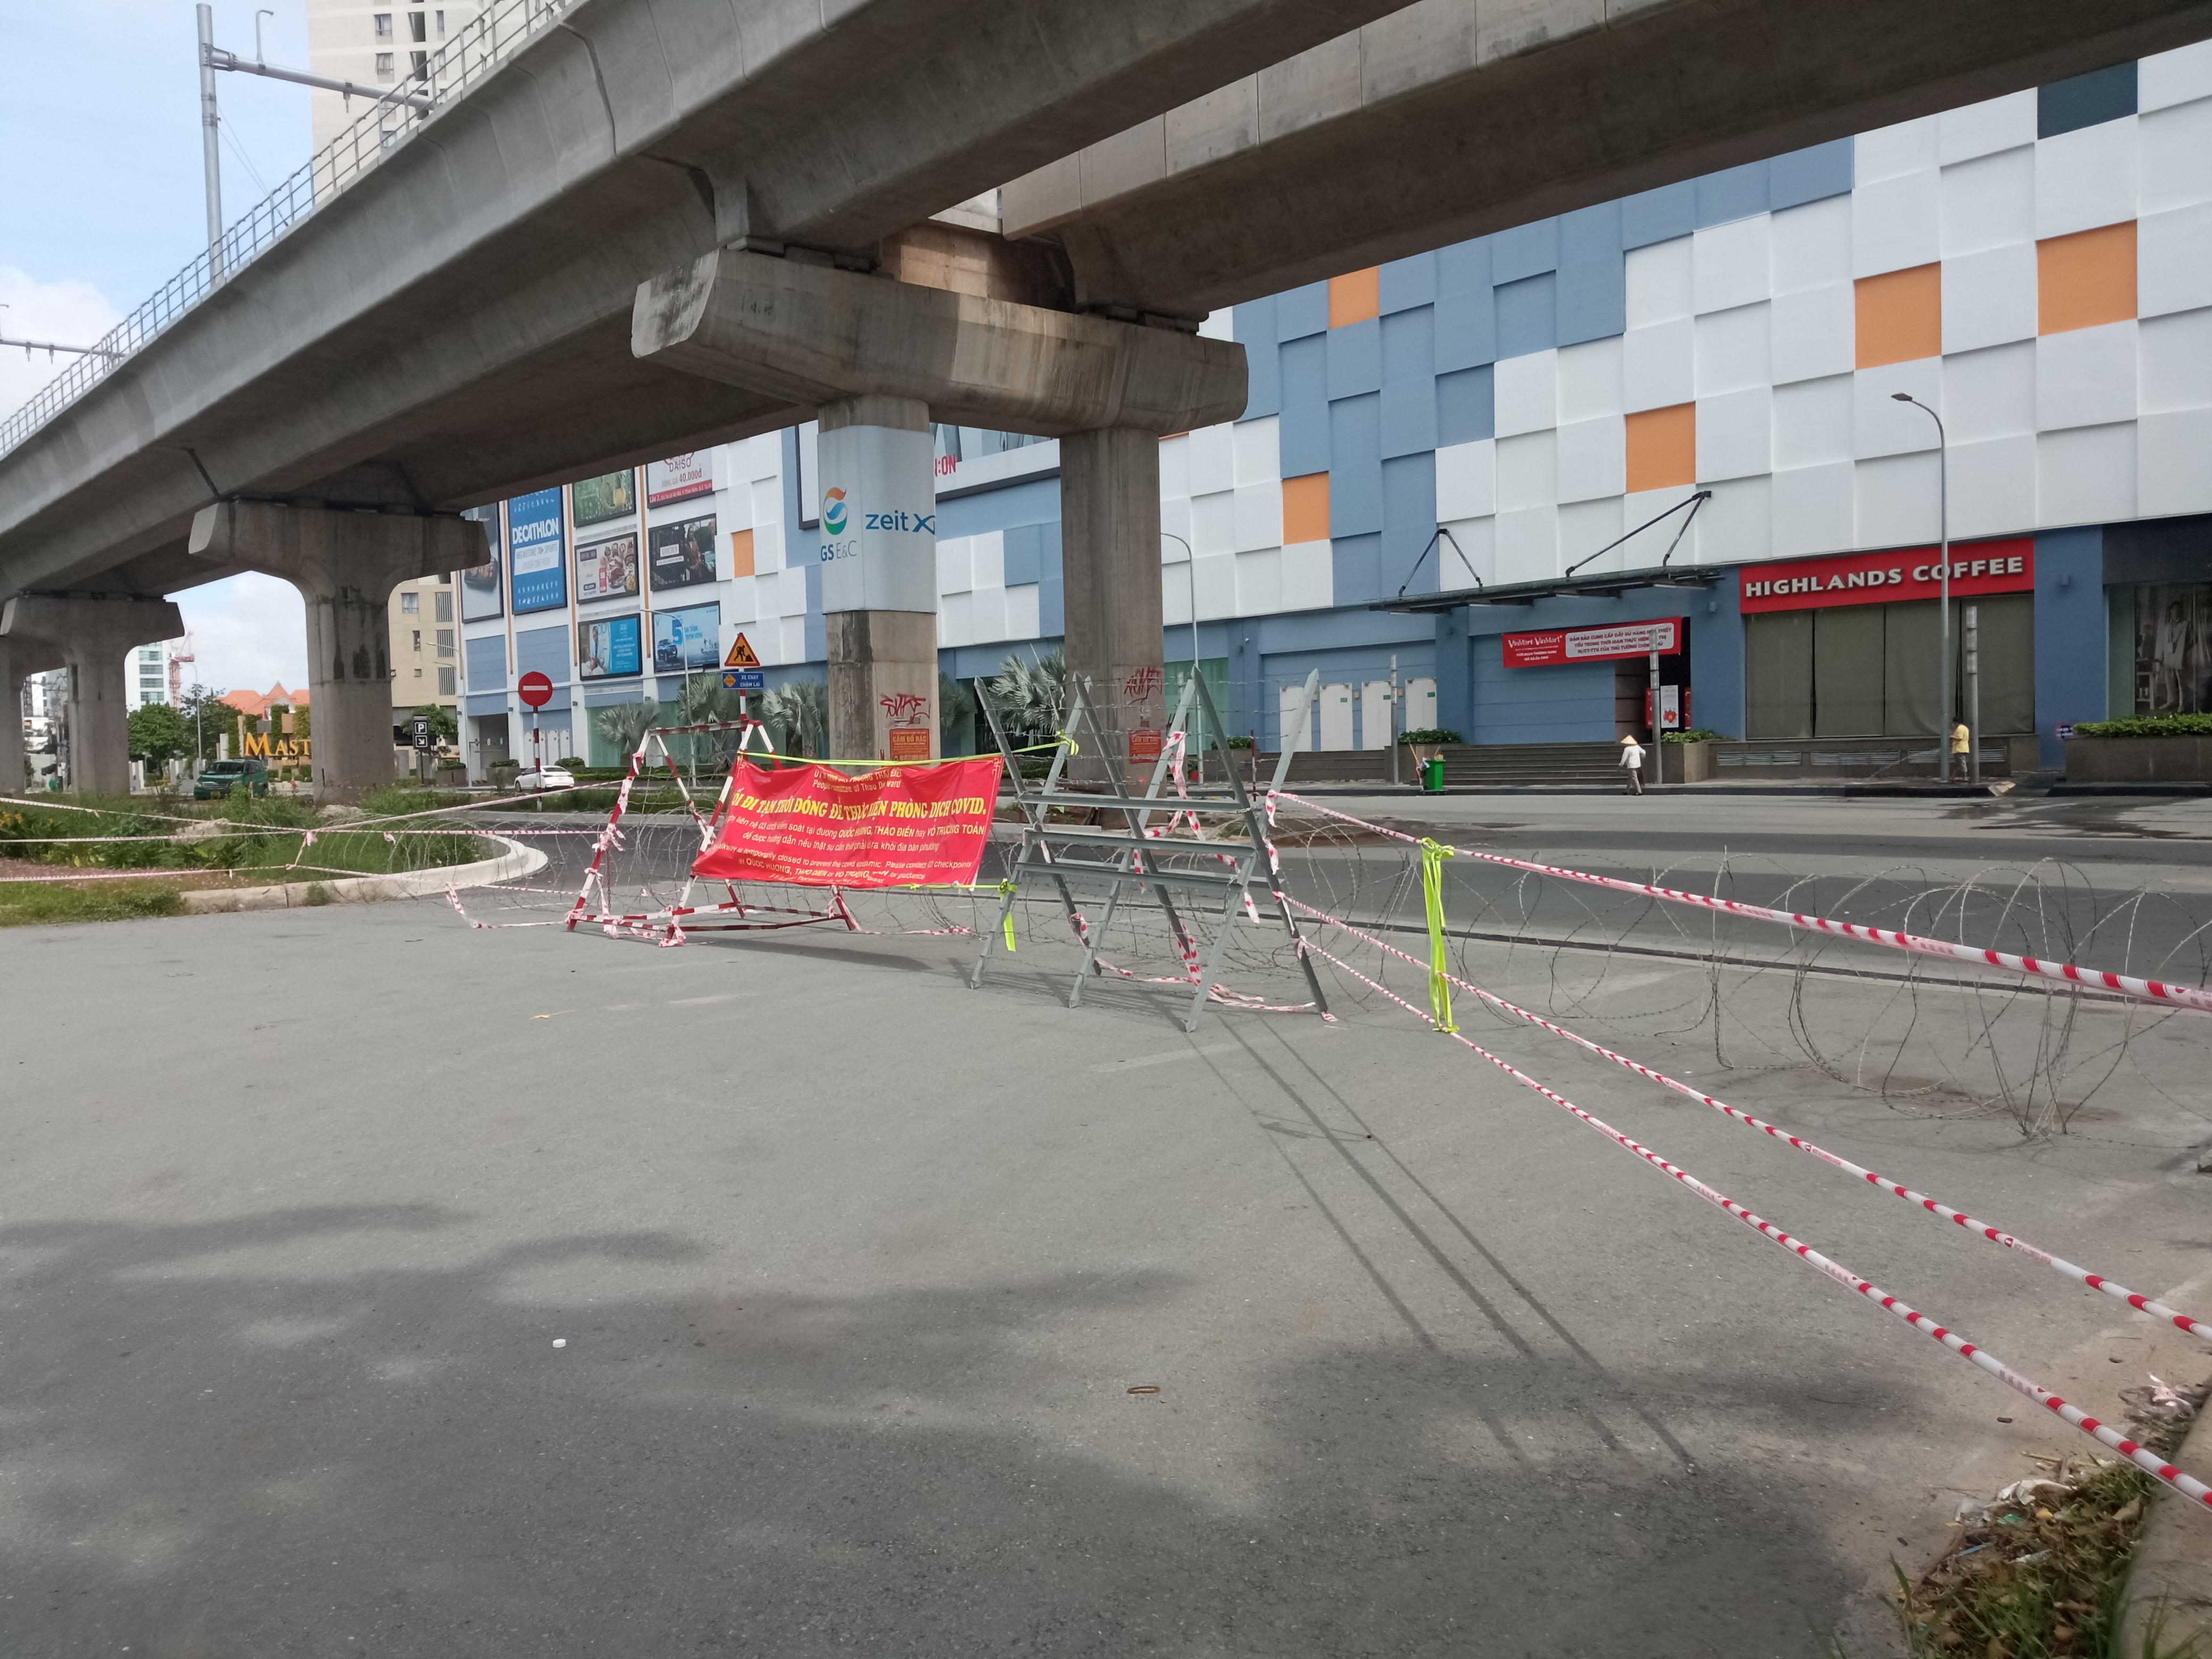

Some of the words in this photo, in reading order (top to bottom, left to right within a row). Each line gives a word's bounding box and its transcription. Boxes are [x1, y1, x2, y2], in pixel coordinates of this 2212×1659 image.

[669, 457, 691, 473] DAISO
[679, 468, 702, 483] 40.000đ
[512, 517, 559, 544] DECATHLON
[820, 543, 834, 562] GS
[836, 540, 858, 559] E&C
[1745, 568, 1903, 597] HIGHLANDS
[1913, 556, 2023, 582] COFFEE
[1508, 639, 1533, 648] VinMart
[418, 724, 424, 733] P
[860, 783, 877, 791] Thao
[740, 795, 759, 810] ĐI
[756, 799, 777, 817] TẠM
[774, 794, 793, 814] THỜI
[793, 795, 828, 817] ĐÓNG
[889, 798, 928, 819] PHÒNG
[928, 799, 952, 822] DỊCH
[951, 797, 987, 815] COVID.
[788, 823, 805, 833] soát
[806, 825, 815, 835] tại
[874, 823, 895, 836] THẢO
[915, 828, 926, 839] hay
[962, 822, 986, 835] TOẢN
[782, 834, 797, 845] dẫn
[745, 857, 765, 868] QUOC
[777, 854, 802, 865] closed
[802, 857, 809, 866] to
[934, 859, 973, 870] checkpoints
